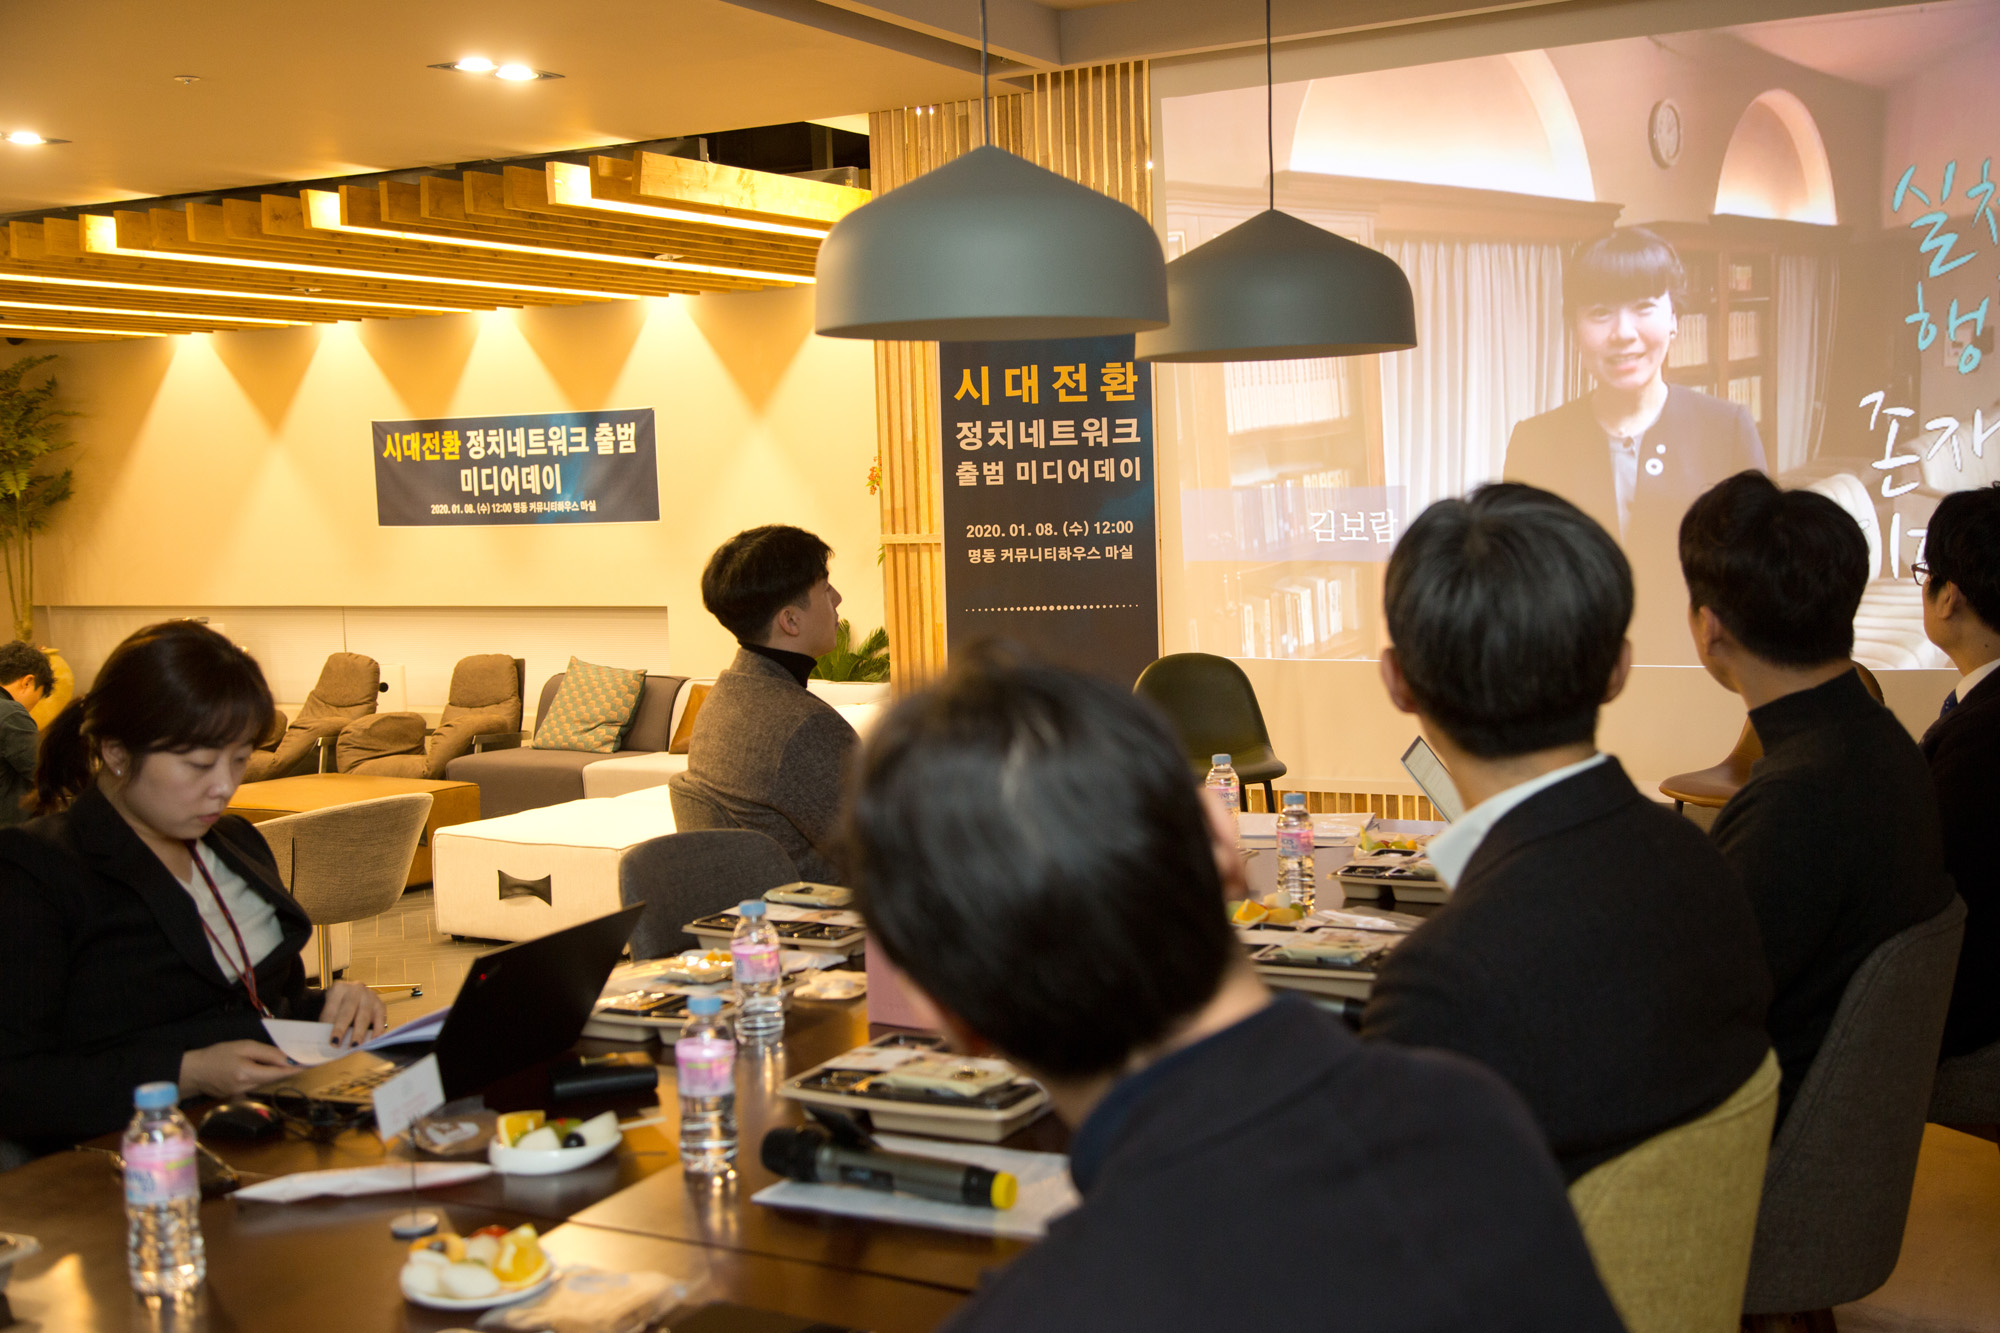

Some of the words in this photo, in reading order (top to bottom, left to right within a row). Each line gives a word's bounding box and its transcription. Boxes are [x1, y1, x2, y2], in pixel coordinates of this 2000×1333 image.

[954, 362, 1138, 405] 시대전환
[383, 430, 461, 462] 시대전환
[466, 425, 589, 459] 정치네트워크
[594, 422, 636, 455] 출범
[956, 417, 1141, 450] 정치네트워크
[460, 464, 562, 496] 미디어데이
[956, 461, 1004, 486] 출범
[1017, 457, 1141, 484] 미디어데이
[431, 504, 450, 514] 2020.
[477, 502, 490, 514] (수)
[492, 503, 512, 513] 12:00
[513, 502, 528, 513] 명동
[529, 501, 580, 513] 커뮤니티하우스
[580, 500, 597, 512] 마실
[966, 524, 1005, 538] 2020.
[1009, 523, 1032, 537] 01.
[1035, 522, 1058, 536] 08.
[1063, 521, 1089, 537] (수)
[1094, 520, 1134, 535] 12:00
[1309, 508, 1399, 544] 김보람
[968, 548, 996, 563] 명동
[1001, 546, 1101, 563] 커뮤니티하우스
[1105, 544, 1133, 560] 마실
